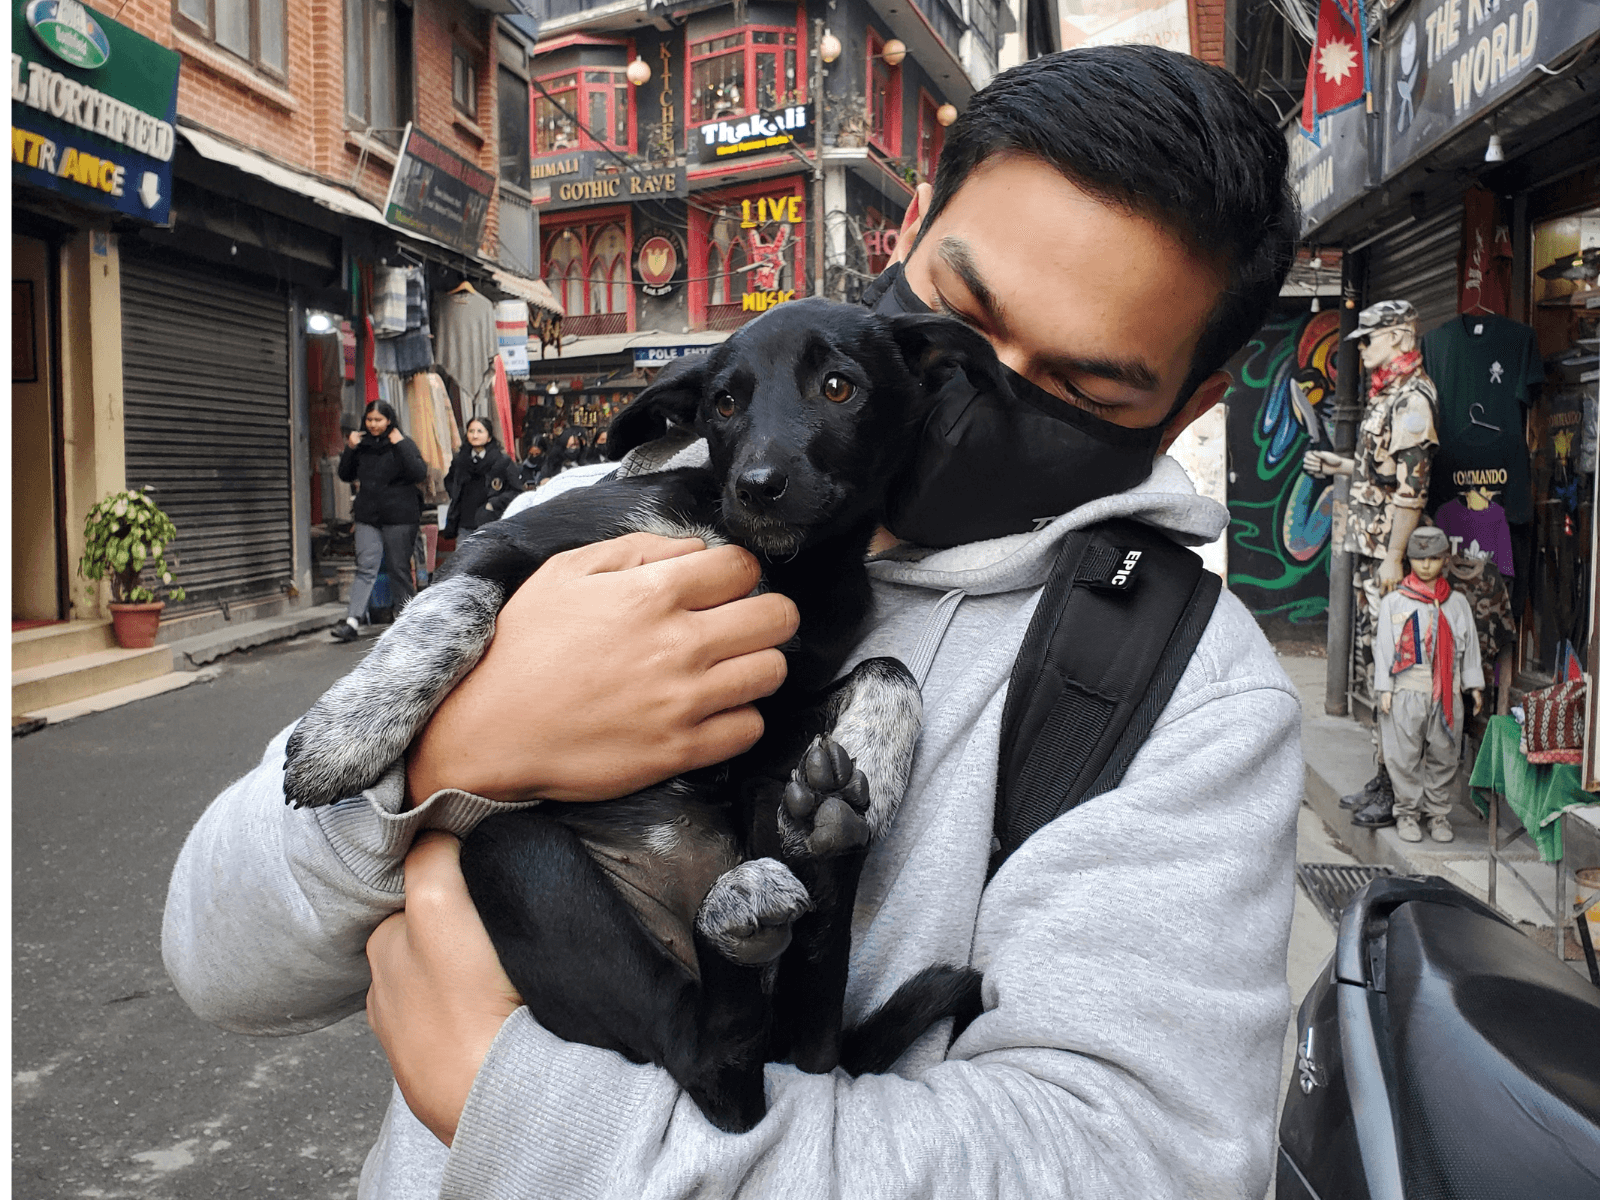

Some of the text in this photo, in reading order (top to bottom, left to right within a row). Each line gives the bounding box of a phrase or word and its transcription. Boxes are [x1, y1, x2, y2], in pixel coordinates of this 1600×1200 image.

[1425, 0, 1462, 68] THE
[1452, 0, 1539, 115] WORLD
[28, 61, 176, 163] NORTHFIELD
[531, 158, 579, 180] HIMALI
[559, 173, 676, 201] GOTHIC RAVE
[740, 196, 802, 228] LIVE
[648, 348, 678, 360] POLE
[1111, 550, 1142, 586] EPIC
